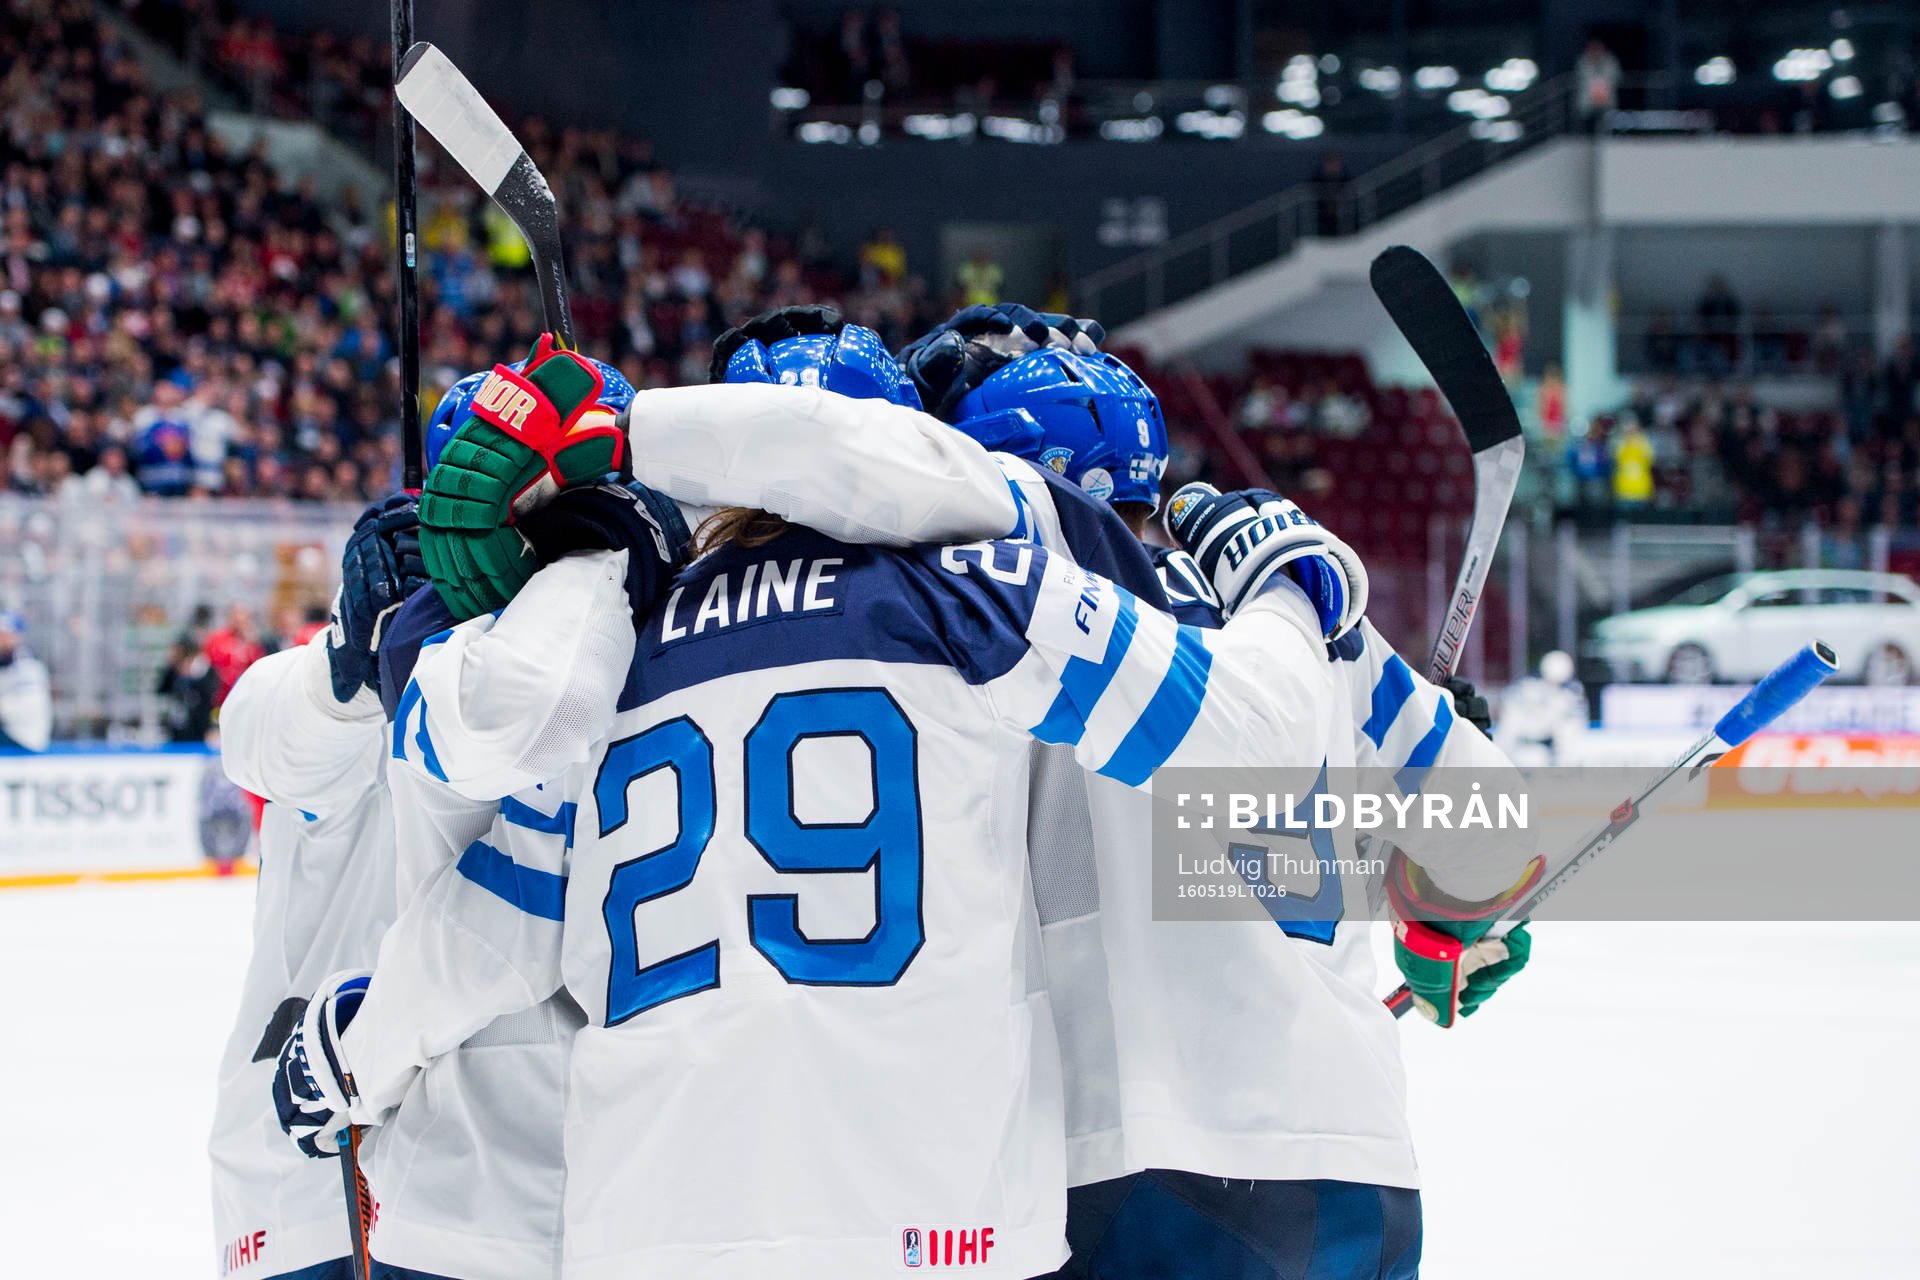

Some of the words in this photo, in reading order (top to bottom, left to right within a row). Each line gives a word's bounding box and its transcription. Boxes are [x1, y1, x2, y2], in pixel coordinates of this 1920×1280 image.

[1136, 418, 1151, 449] 9
[661, 558, 843, 644] LAINE
[3, 776, 172, 822] TISSOT
[592, 686, 927, 1029] 29
[229, 1230, 267, 1273] IIHF
[929, 1227, 994, 1266] IIHF
